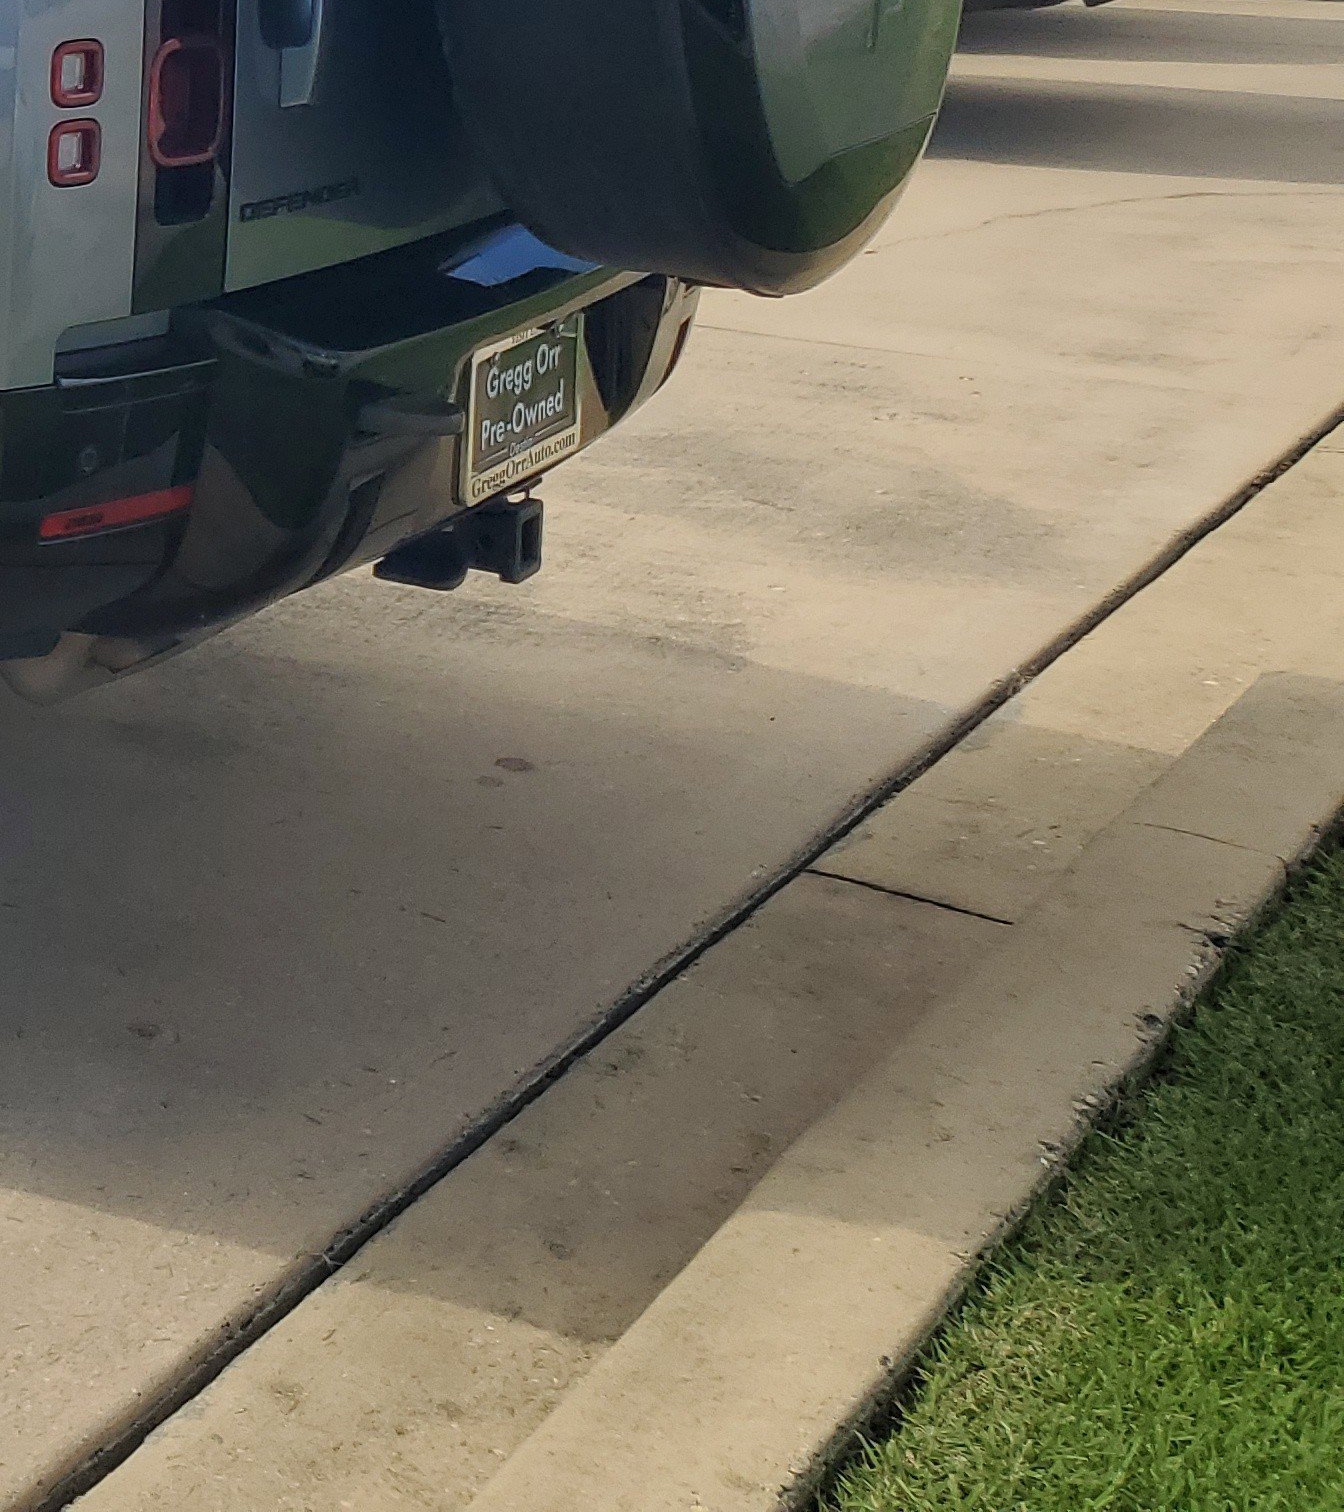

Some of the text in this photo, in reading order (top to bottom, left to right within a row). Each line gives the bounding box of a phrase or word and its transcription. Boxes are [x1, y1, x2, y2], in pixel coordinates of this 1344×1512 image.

[486, 343, 562, 400] Gregg Orr
[481, 378, 564, 450] Pre-Owned
[471, 431, 576, 499] GreggOrrAuto.com
